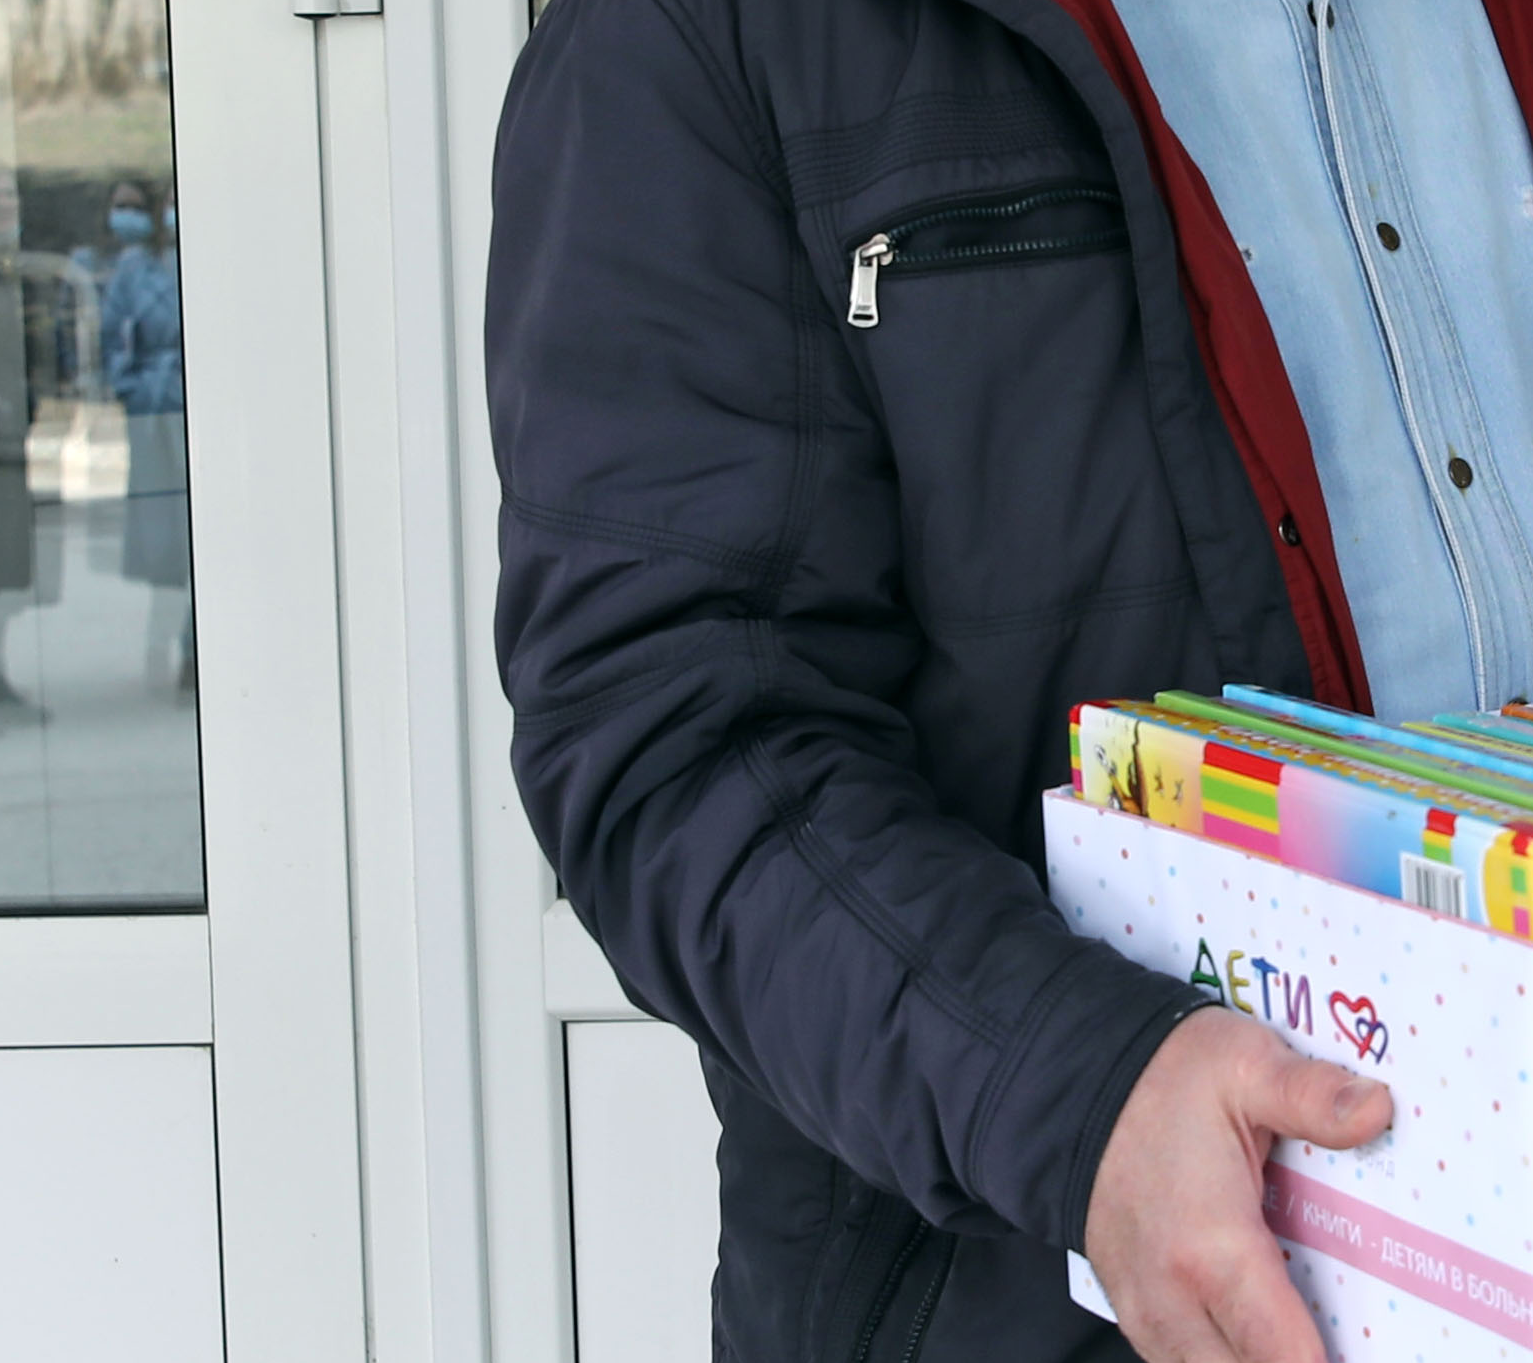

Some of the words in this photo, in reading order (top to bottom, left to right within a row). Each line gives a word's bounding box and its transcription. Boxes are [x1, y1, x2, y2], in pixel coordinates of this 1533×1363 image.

[1190, 937, 1313, 1036] ДЕТИ
[1302, 1200, 1363, 1249] КНИГИ
[1381, 1237, 1447, 1286] ДЕТЯМ
[1450, 1269, 1465, 1293] В
